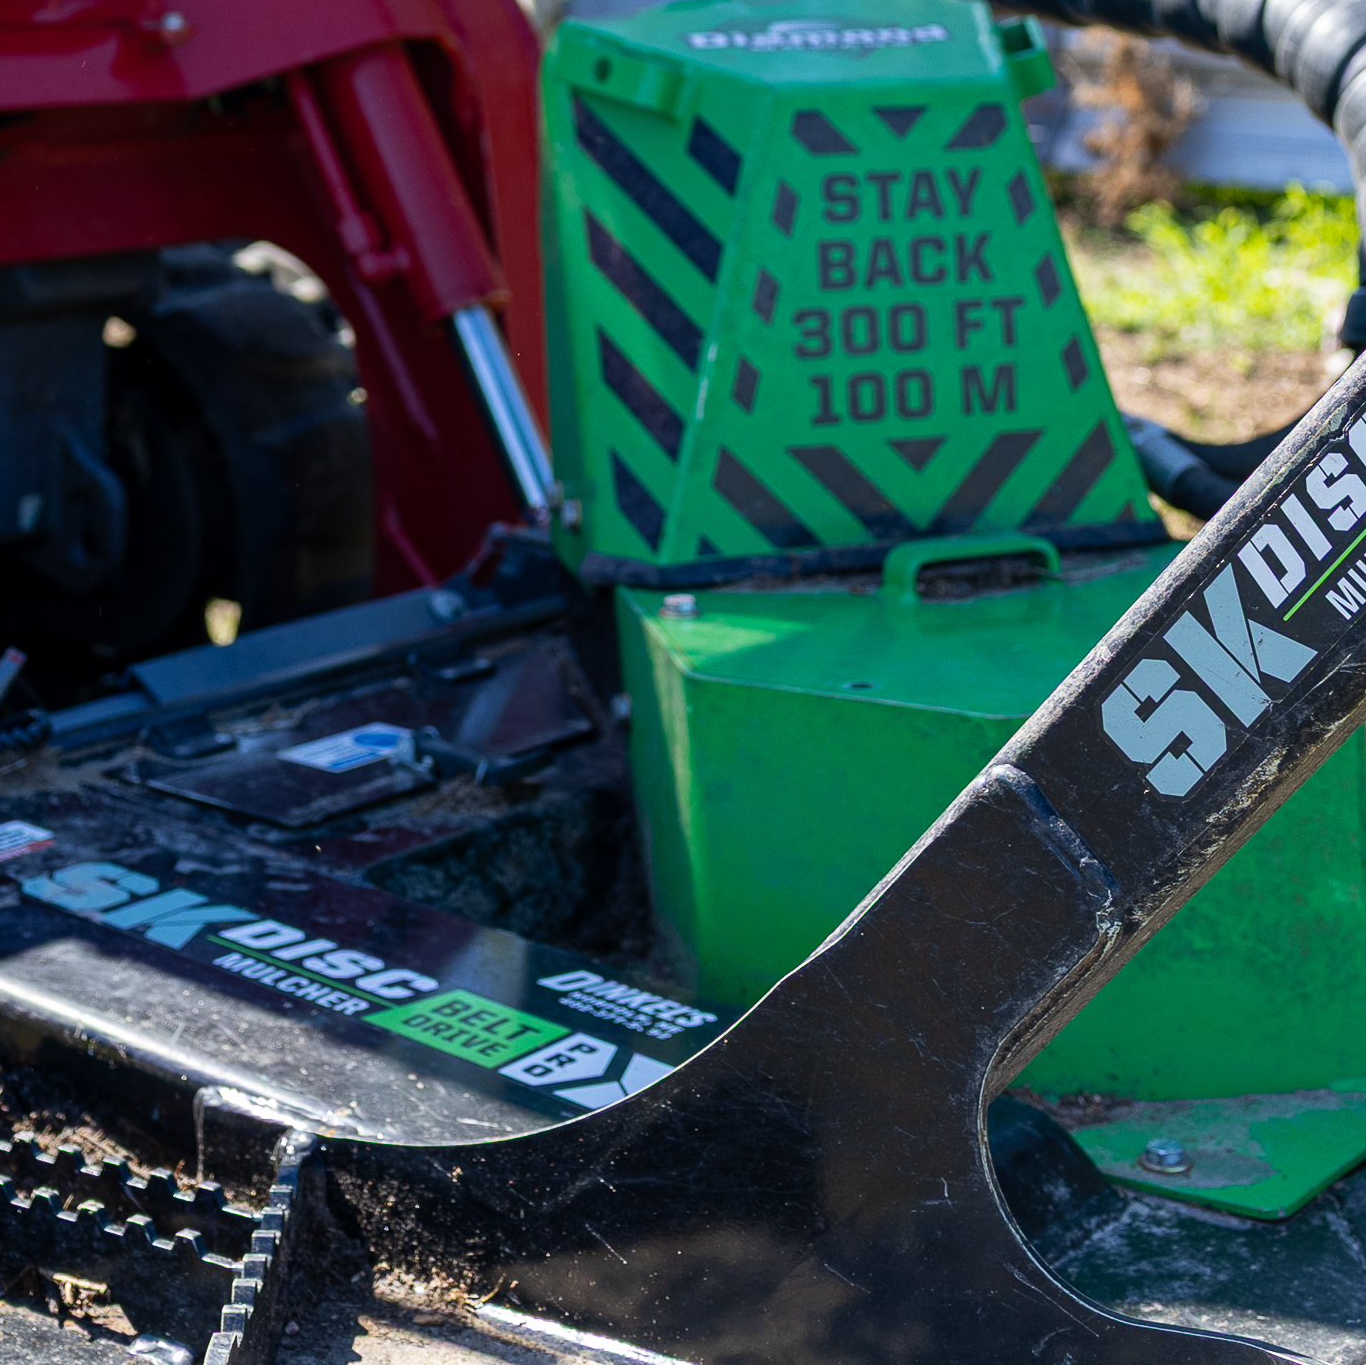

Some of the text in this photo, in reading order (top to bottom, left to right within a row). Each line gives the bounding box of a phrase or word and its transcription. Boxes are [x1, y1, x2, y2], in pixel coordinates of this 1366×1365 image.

[823, 168, 983, 224] STAY
[818, 232, 994, 291] BACK
[794, 296, 1025, 360] 300 FT
[810, 364, 1017, 426] 100 M
[1101, 561, 1318, 800] SK
[20, 860, 440, 1002] SK DISC
[213, 951, 370, 1018] MULCHER
[536, 970, 718, 1028] DINKEL'S
[399, 1011, 510, 1061] DRIVE
[431, 988, 542, 1049] BELT
[521, 1042, 599, 1079] PRO
